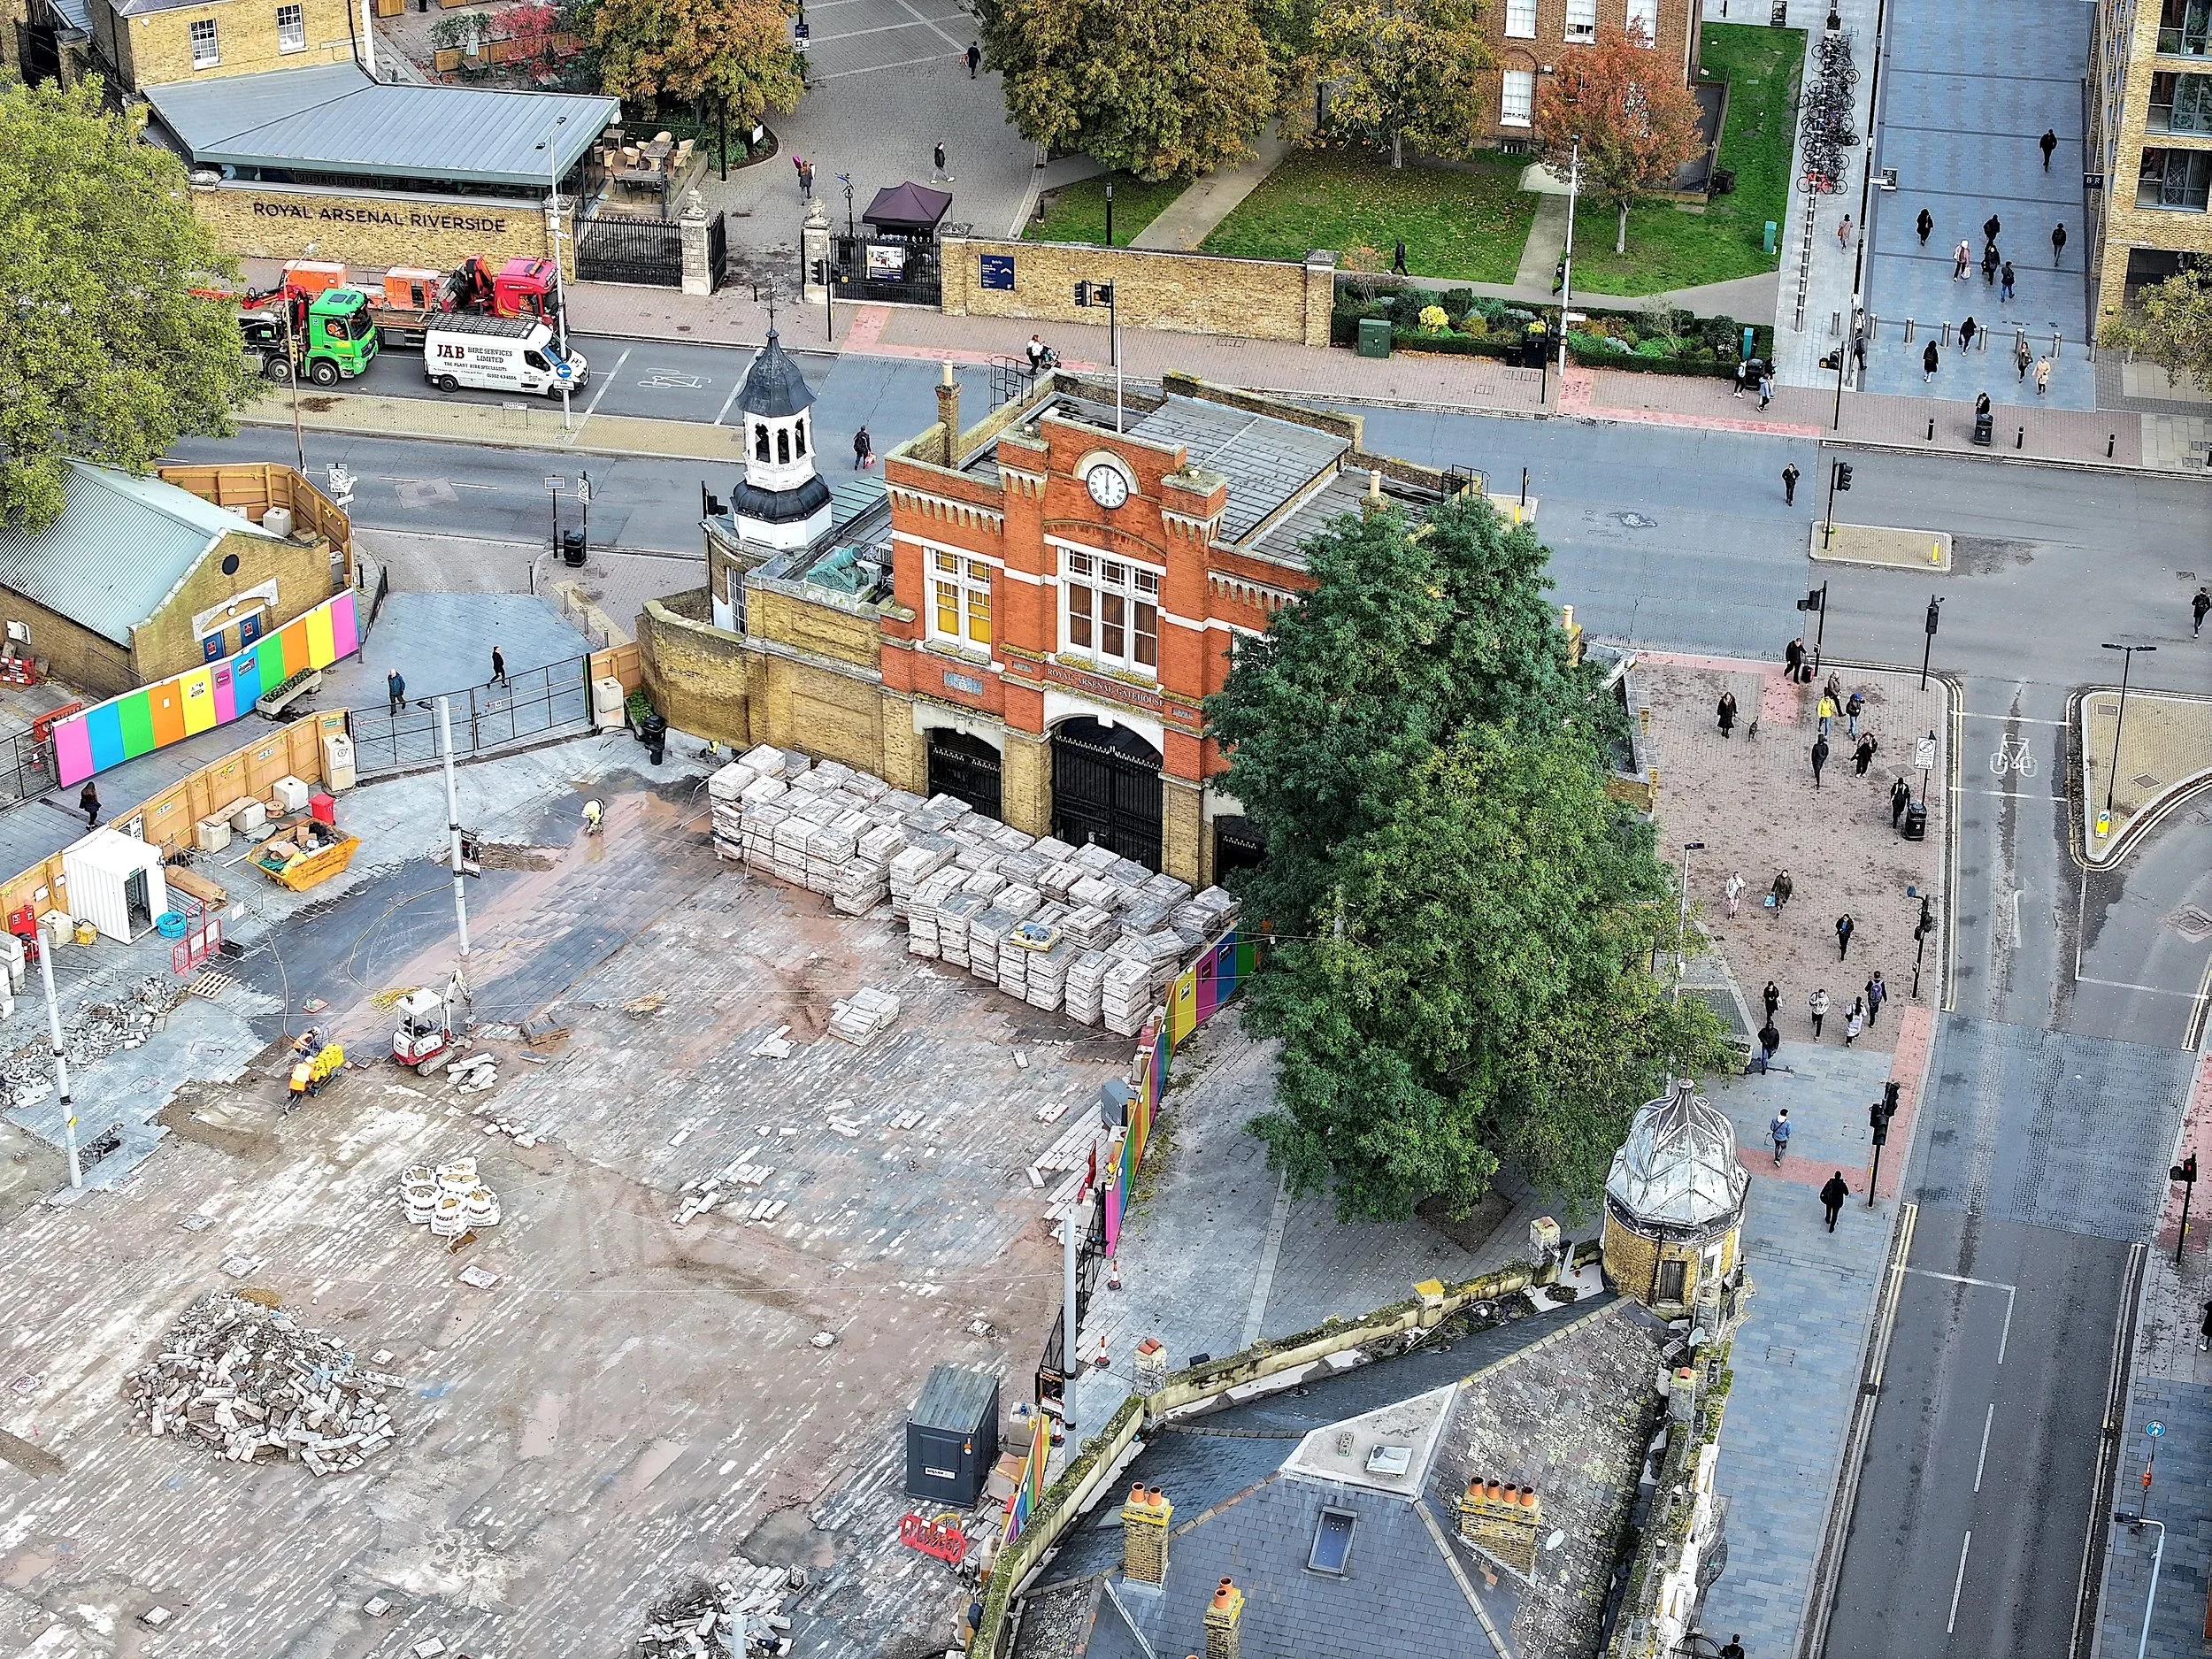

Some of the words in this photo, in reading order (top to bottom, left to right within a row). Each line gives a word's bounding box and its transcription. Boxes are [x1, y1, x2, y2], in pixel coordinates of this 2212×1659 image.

[296, 173, 336, 186] PUBLIC
[337, 176, 378, 188] HOUSE
[253, 203, 313, 219] ROYAL
[319, 208, 404, 226] ARSENAL
[411, 213, 506, 233] RIVERSIDE
[437, 344, 465, 359] JAB
[484, 348, 513, 357] SERVICES
[1047, 668, 1073, 681] ROYAL
[1078, 676, 1115, 693] ARSENAL
[1116, 687, 1164, 707] GATEHOUSE
